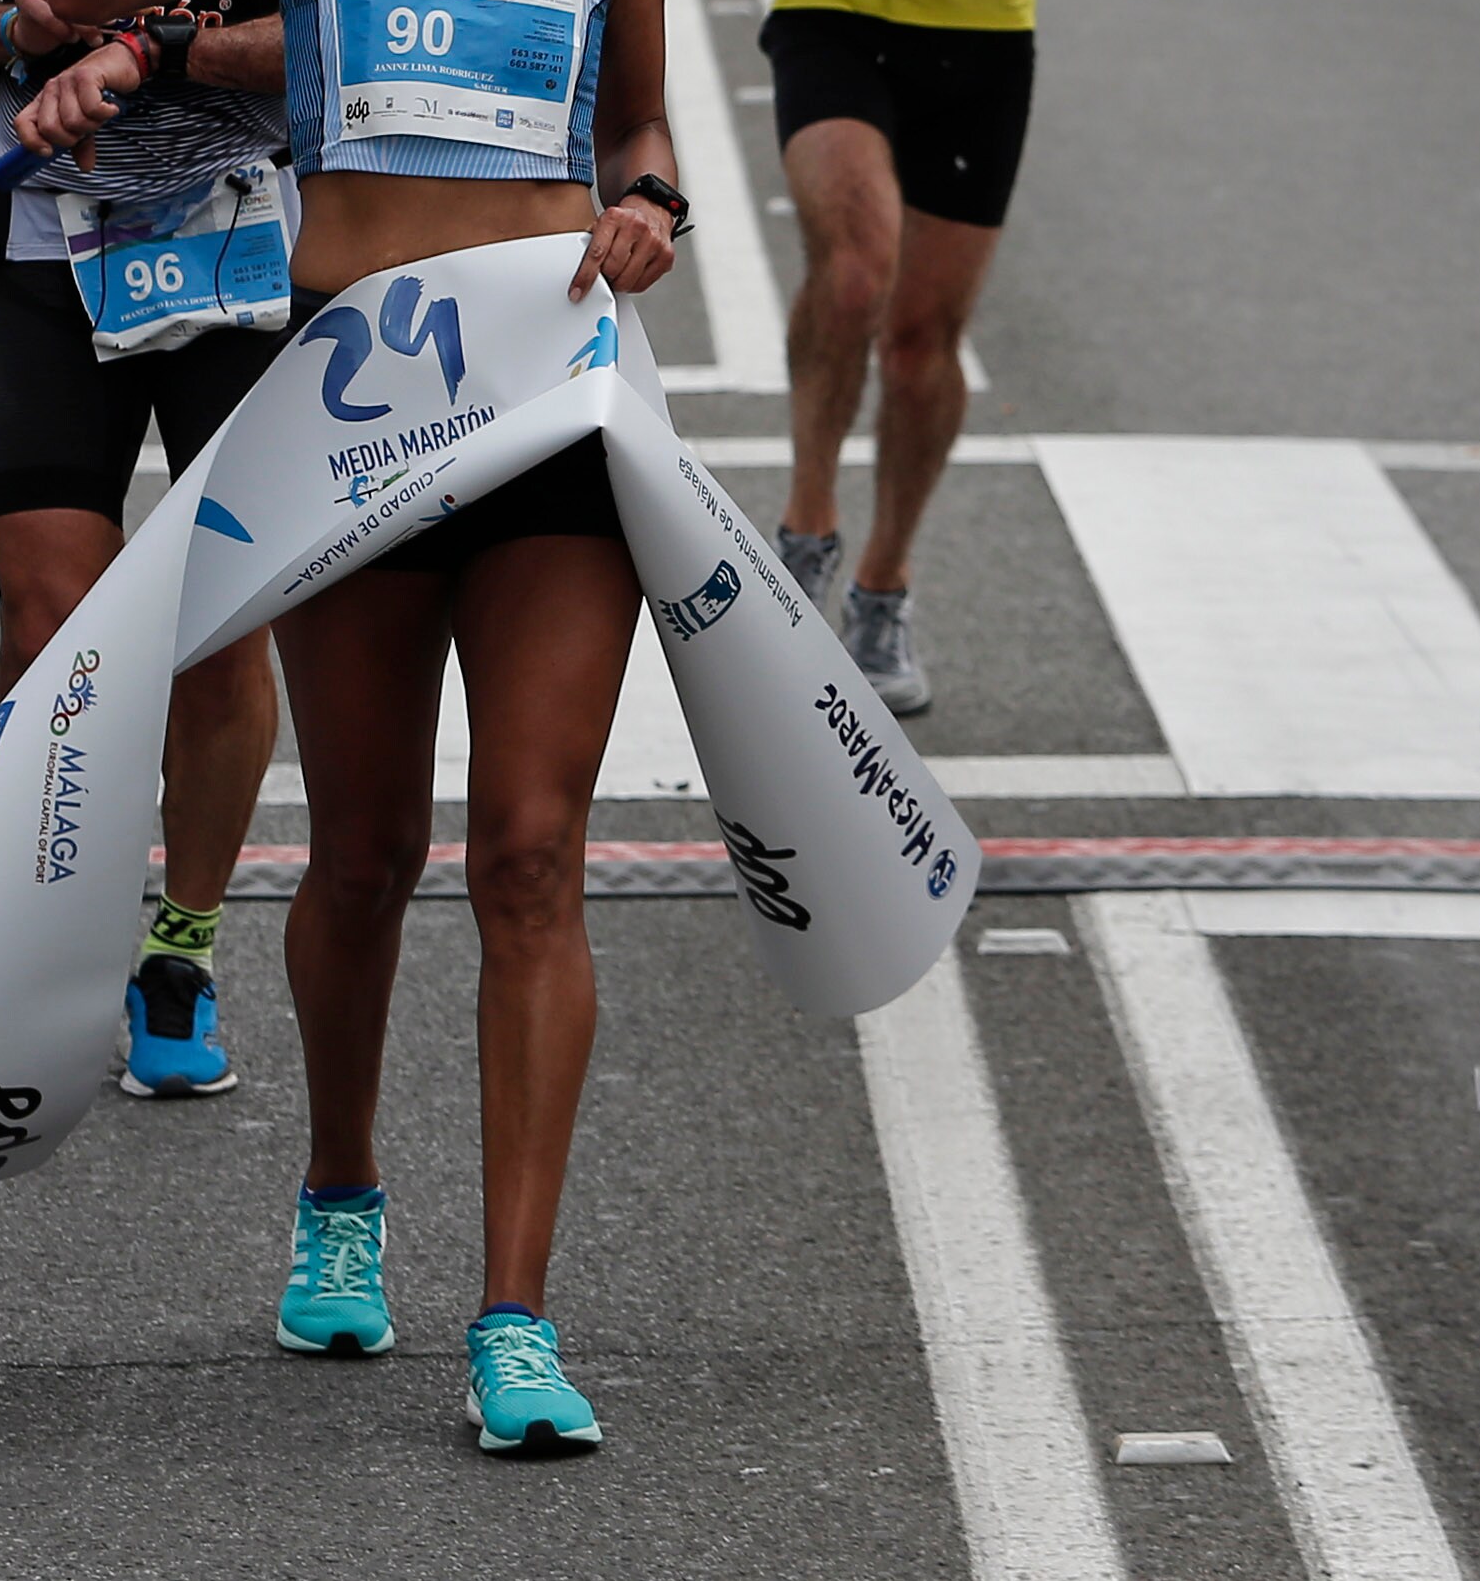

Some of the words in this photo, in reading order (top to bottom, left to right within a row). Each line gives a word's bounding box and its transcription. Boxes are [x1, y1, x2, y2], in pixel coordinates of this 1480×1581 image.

[387, 6, 455, 57] 90
[375, 63, 409, 72] JANINE
[411, 63, 437, 74] LIMA
[439, 65, 495, 82] RODRIGUEZ
[529, 62, 547, 72] 587
[548, 65, 562, 75] 141
[532, 51, 549, 62] 587
[552, 54, 564, 64] 111
[345, 97, 370, 124] edp
[124, 252, 185, 302] 96
[120, 299, 164, 323] FRANCISCO
[164, 299, 188, 308] LUNA
[298, 275, 466, 422] 29
[328, 437, 398, 481] MEDIA
[398, 403, 496, 460] MARATÓN
[380, 471, 434, 519] CIUDAD
[678, 456, 719, 517] Málaga
[358, 514, 380, 537] DE
[719, 508, 734, 532] de
[298, 529, 361, 582] MÁLAGA
[733, 528, 803, 628] Ayuntamiento
[43, 742, 58, 796] EUROPEAN
[39, 797, 52, 837] CAPITAL
[48, 744, 90, 884] MÁLAGA
[37, 838, 48, 852] OF
[35, 853, 47, 885] SPORT
